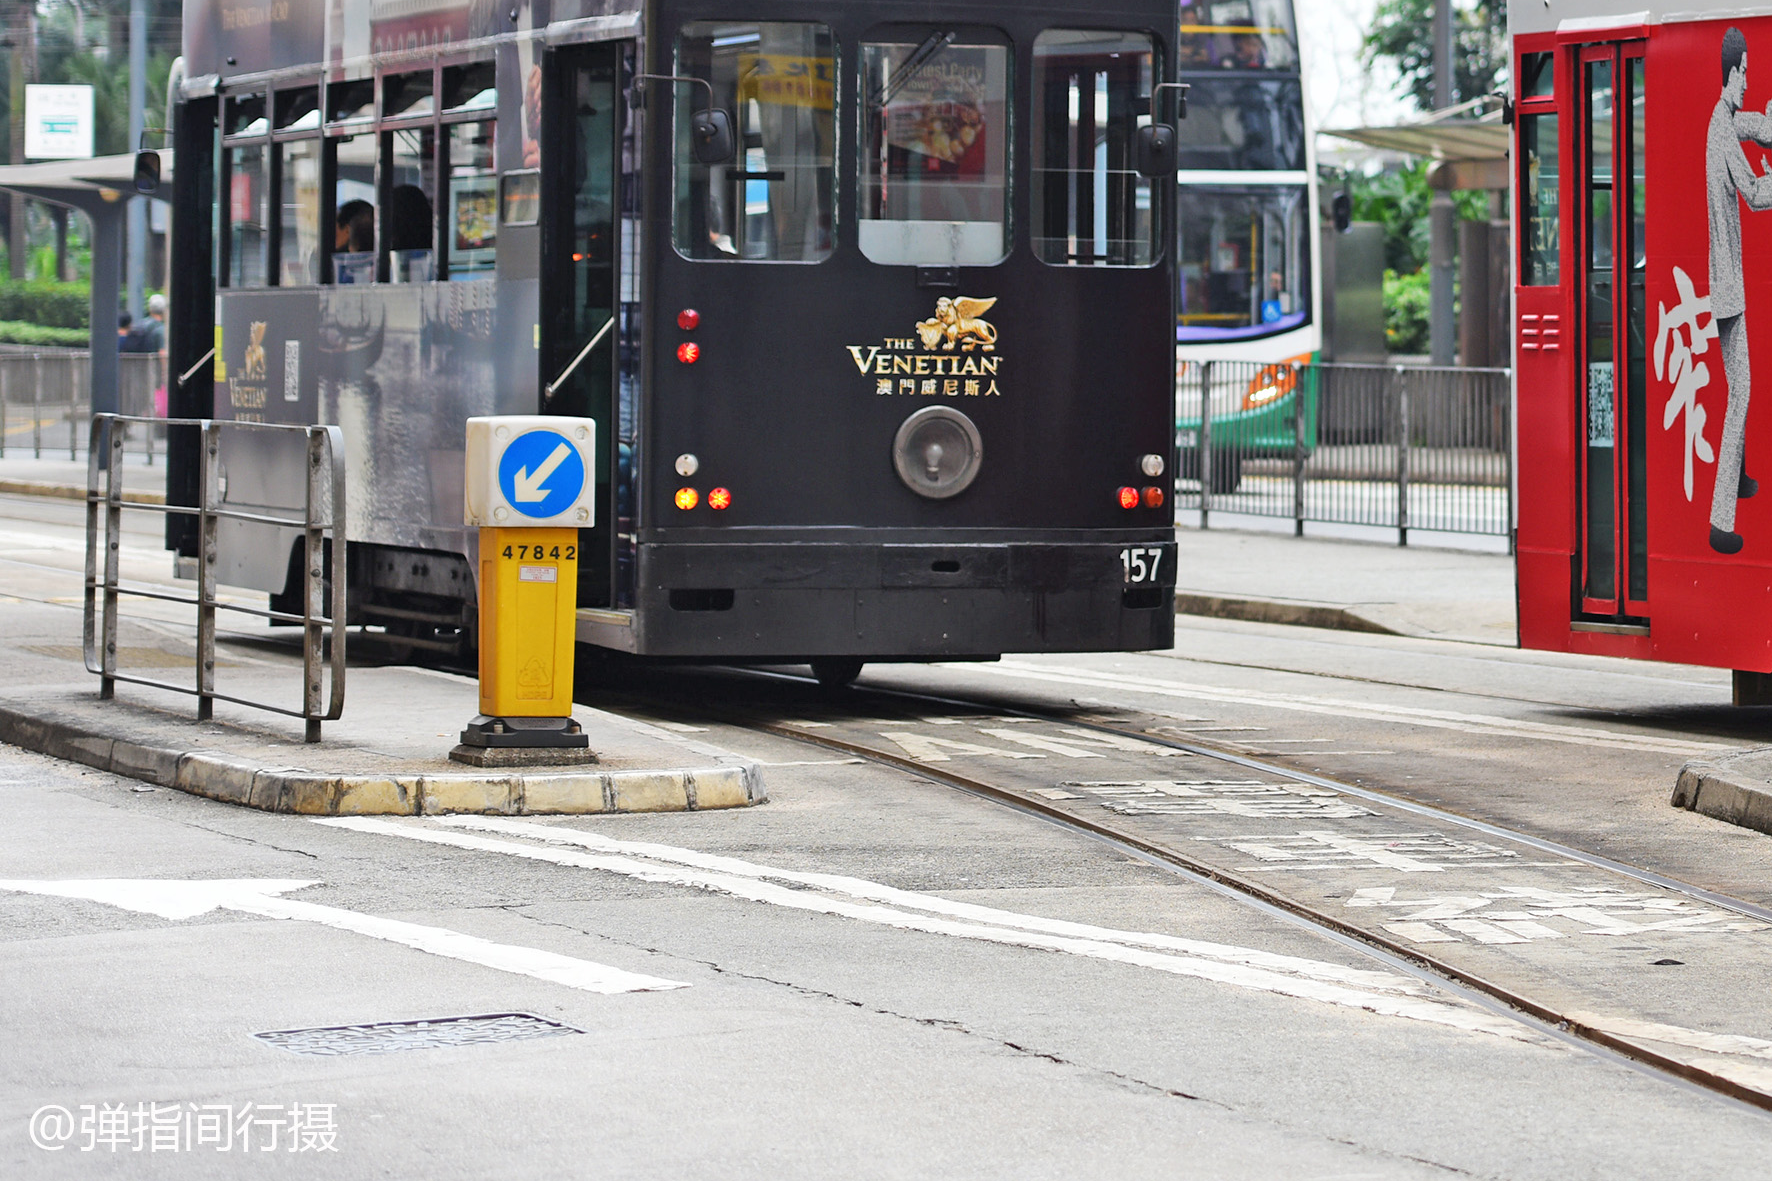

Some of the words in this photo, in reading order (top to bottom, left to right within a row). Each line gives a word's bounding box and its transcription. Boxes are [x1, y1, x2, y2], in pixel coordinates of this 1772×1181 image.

[884, 337, 916, 350] THE
[846, 344, 1002, 378] VENETIAN
[875, 378, 1002, 397] 澳門威尼斯人
[502, 545, 577, 561] 47842
[1119, 547, 1164, 584] 157
